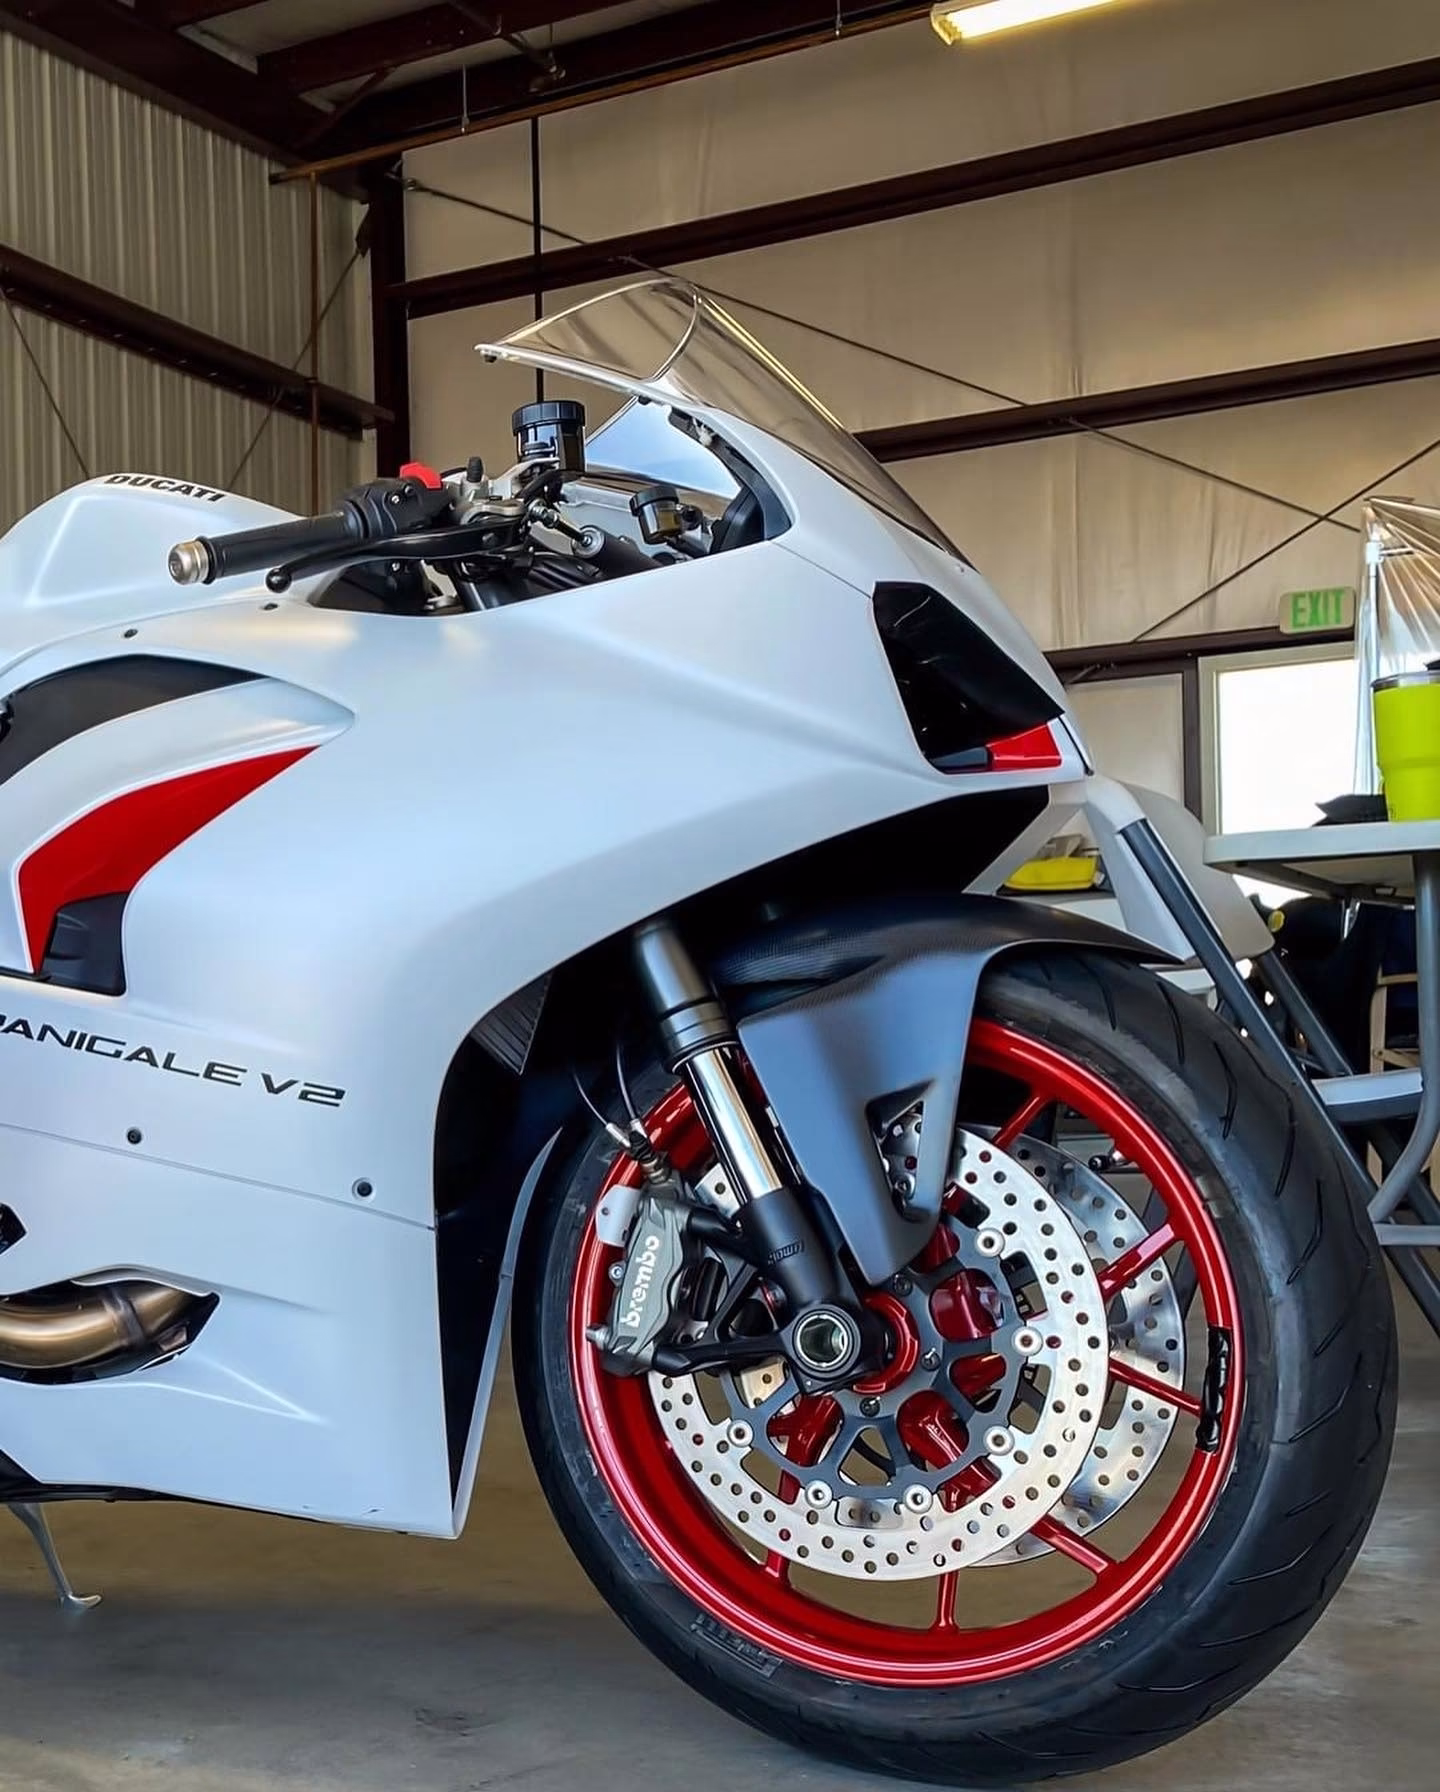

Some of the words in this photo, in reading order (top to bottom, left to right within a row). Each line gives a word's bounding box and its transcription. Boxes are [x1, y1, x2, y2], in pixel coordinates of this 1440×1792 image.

[104, 475, 226, 502] DUCATI
[1291, 589, 1344, 629] EXIT
[0, 1014, 248, 1086] ANIGALE
[260, 1072, 346, 1108] V2
[620, 1235, 660, 1328] brembo
